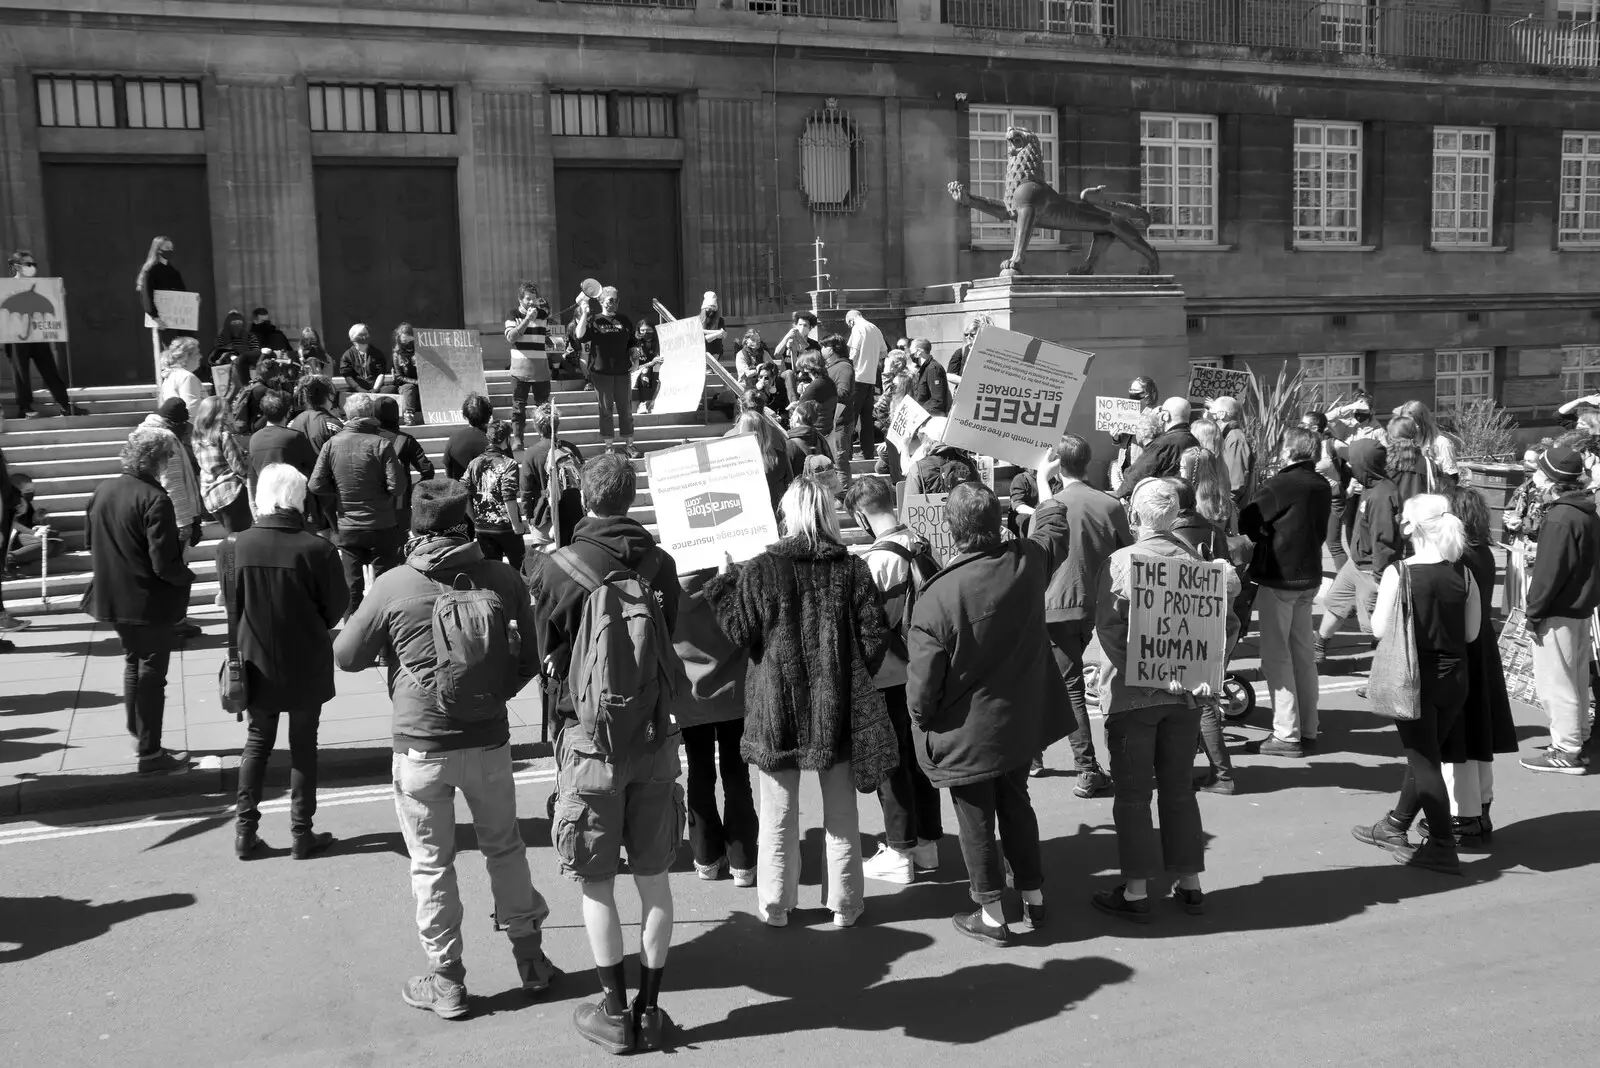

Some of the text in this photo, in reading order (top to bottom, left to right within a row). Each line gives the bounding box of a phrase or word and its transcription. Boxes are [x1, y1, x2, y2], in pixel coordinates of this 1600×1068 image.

[418, 331, 474, 347] KILL THE BILL
[1226, 372, 1250, 381] WHAT
[978, 383, 1064, 402] SELF STORAGE
[1192, 378, 1248, 392] DEMOCRACY
[973, 396, 1060, 428] FREE!
[1099, 400, 1113, 409] NO
[428, 411, 450, 424] KILL
[1098, 412, 1111, 421] NO
[954, 418, 987, 431] storage...
[988, 427, 1002, 436] free
[1011, 434, 1034, 444] month
[912, 520, 950, 534] SO YO
[672, 524, 768, 550] Self storage insurance
[1132, 562, 1222, 592] THE RIGHT
[1134, 586, 1224, 618] TO PROTEST
[1158, 617, 1189, 636] IS A
[1140, 634, 1208, 662] HUMAN
[1138, 662, 1187, 682] RIGHT
